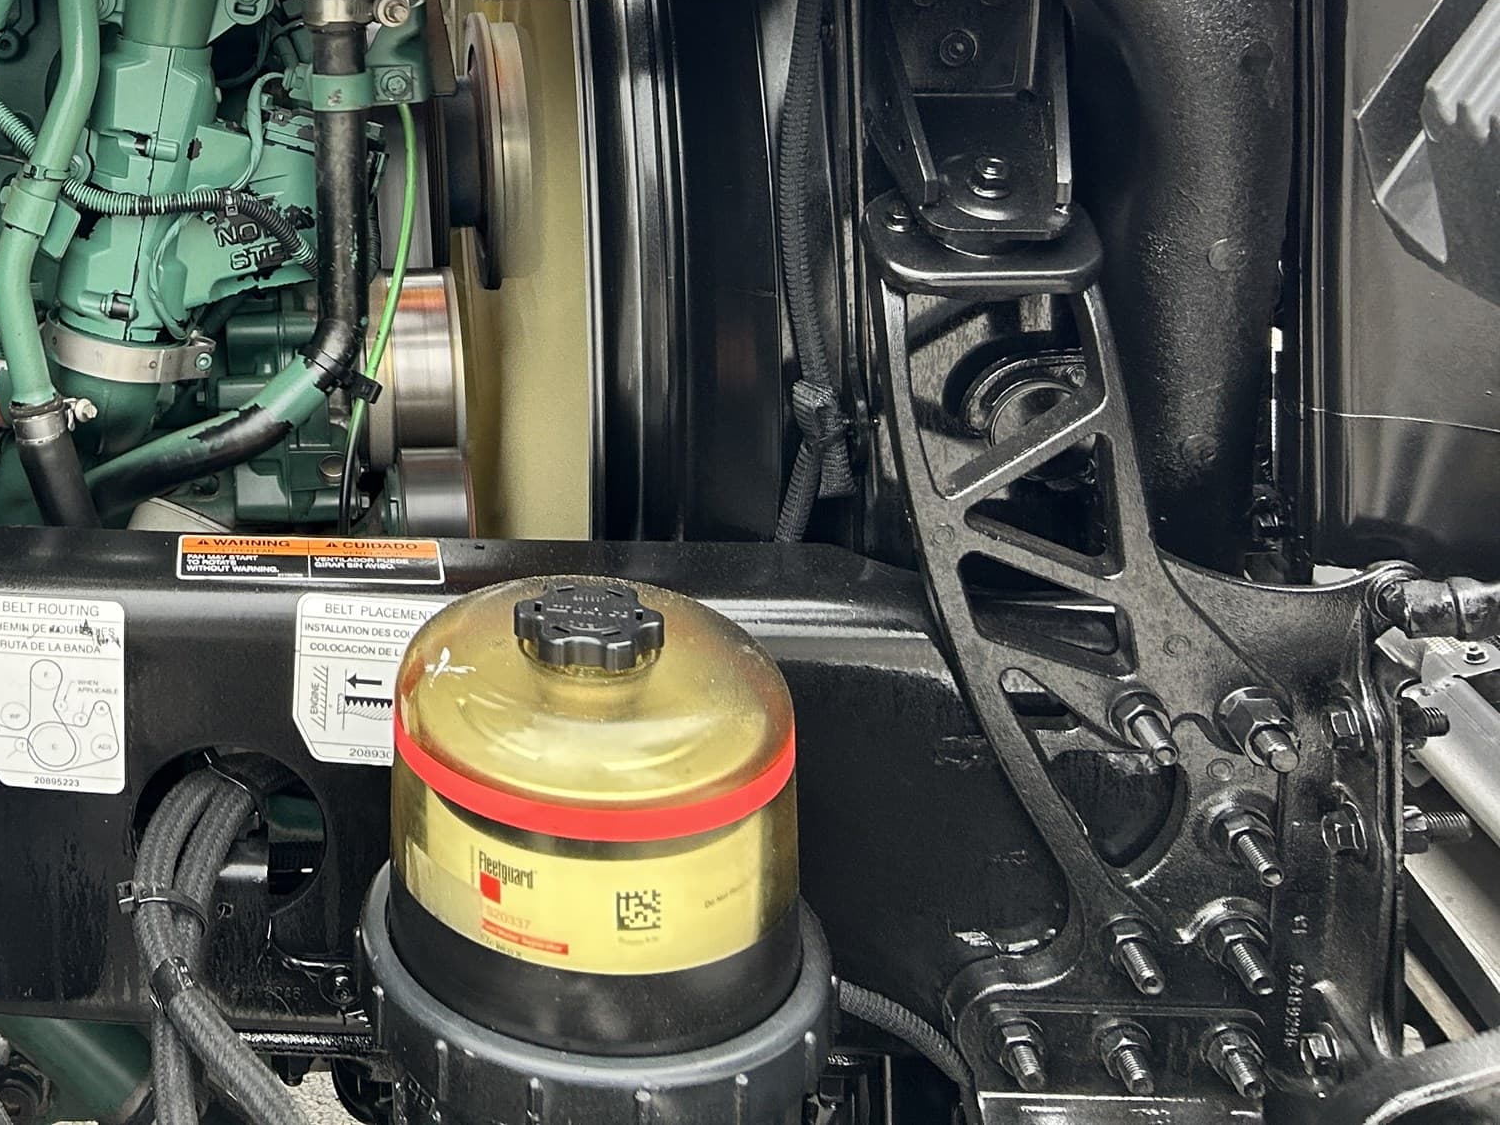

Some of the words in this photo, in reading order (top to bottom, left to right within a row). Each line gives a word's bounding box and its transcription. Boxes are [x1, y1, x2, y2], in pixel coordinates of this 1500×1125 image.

[212, 539, 291, 547] WARNING
[231, 565, 279, 573] WARNING.
[2, 601, 32, 614] BELT
[38, 603, 99, 617] ROUTING
[325, 603, 354, 615] BELT
[32, 624, 47, 634] DE
[304, 623, 369, 638] INSTALLATION
[371, 628, 391, 639] DES
[0, 639, 28, 650] RUTA
[30, 641, 46, 651] DE
[49, 643, 64, 652] LA
[64, 644, 101, 654] BANDA
[310, 642, 375, 657] COLOCACIÓN
[378, 647, 392, 657] DE
[479, 850, 534, 889] Fleetguard
